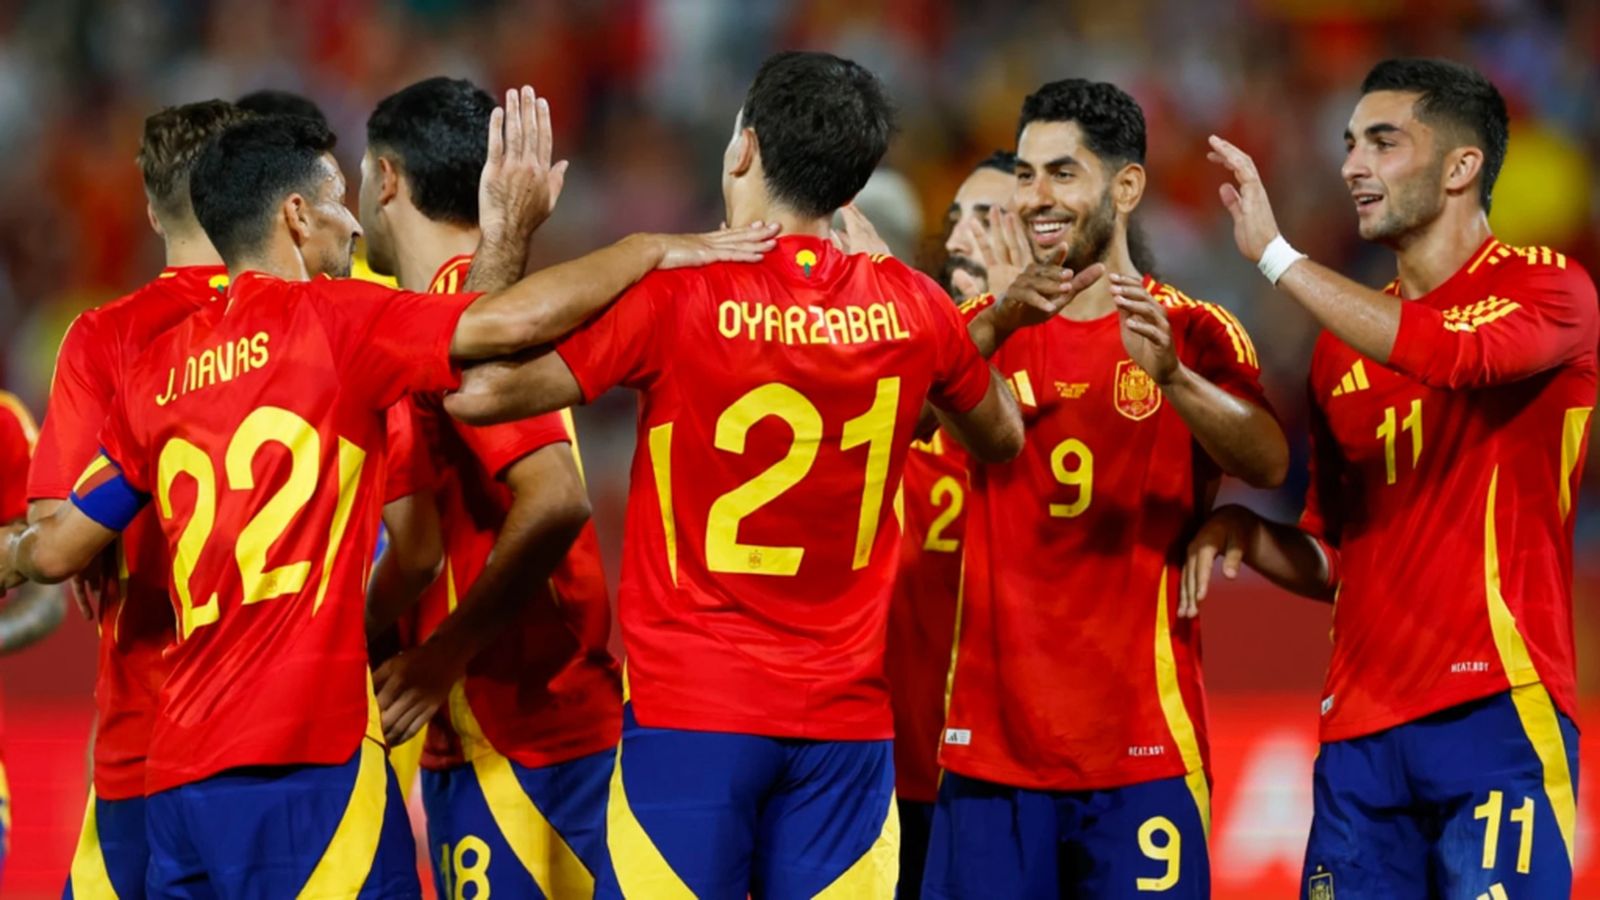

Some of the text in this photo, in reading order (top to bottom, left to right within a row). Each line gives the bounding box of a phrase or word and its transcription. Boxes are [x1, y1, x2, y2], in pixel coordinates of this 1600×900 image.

[718, 300, 909, 344] OYARZABAL
[156, 331, 269, 406] J. NAVAS
[705, 376, 900, 576] 21
[1049, 439, 1093, 517] 9
[1376, 399, 1423, 484] 11
[157, 406, 319, 640] 22
[1136, 816, 1181, 891] 9
[1474, 790, 1534, 874] 11
